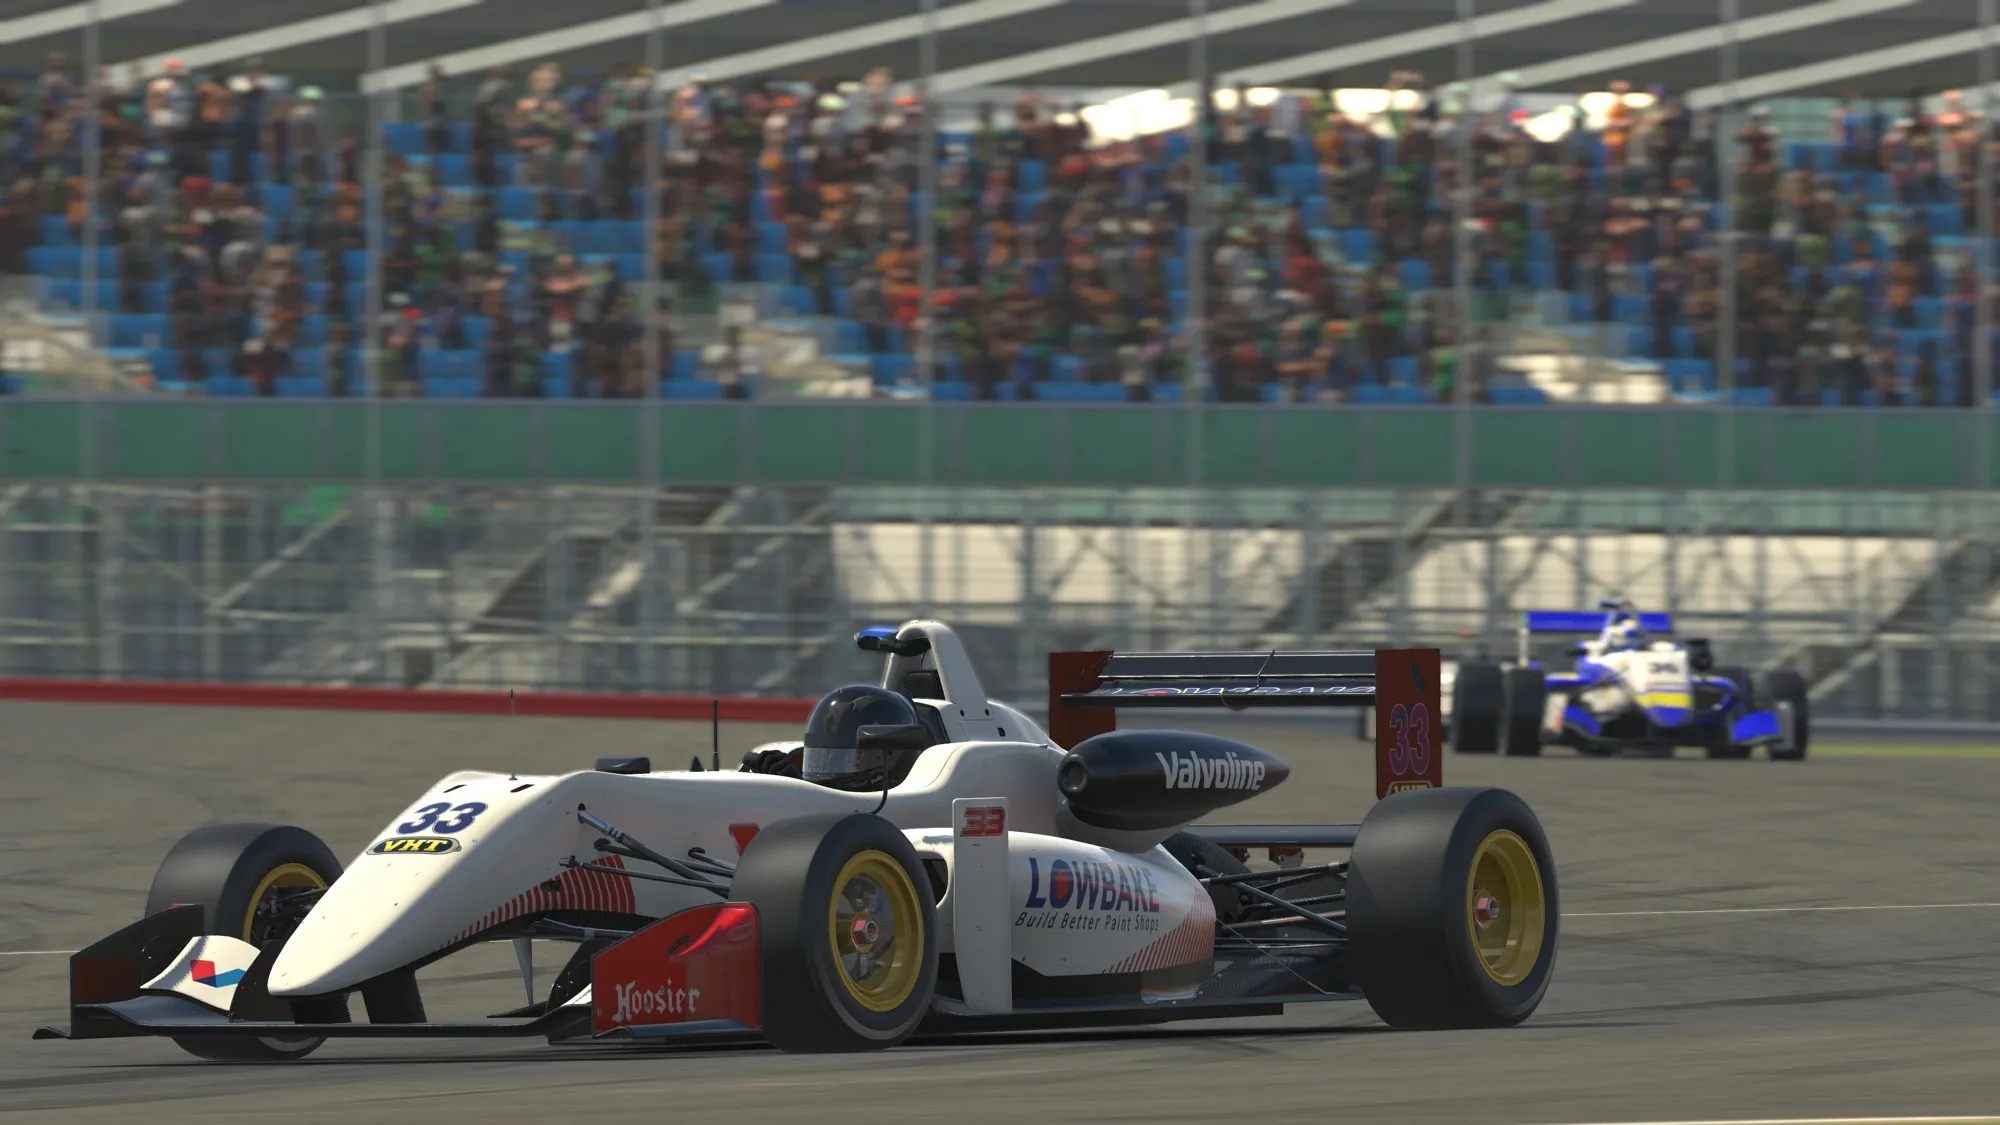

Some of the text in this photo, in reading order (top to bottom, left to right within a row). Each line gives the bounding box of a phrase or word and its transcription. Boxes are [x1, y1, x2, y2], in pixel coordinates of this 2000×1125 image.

[1389, 703, 1430, 775] 33
[1155, 750, 1265, 790] Valvoline
[396, 802, 488, 834] 33
[960, 806, 1005, 837] 33
[383, 839, 448, 852] VHT
[1025, 857, 1160, 913] LOWBAKE
[1014, 911, 1159, 934] Build Better Paint Shops
[612, 977, 700, 1022] Hoosier
